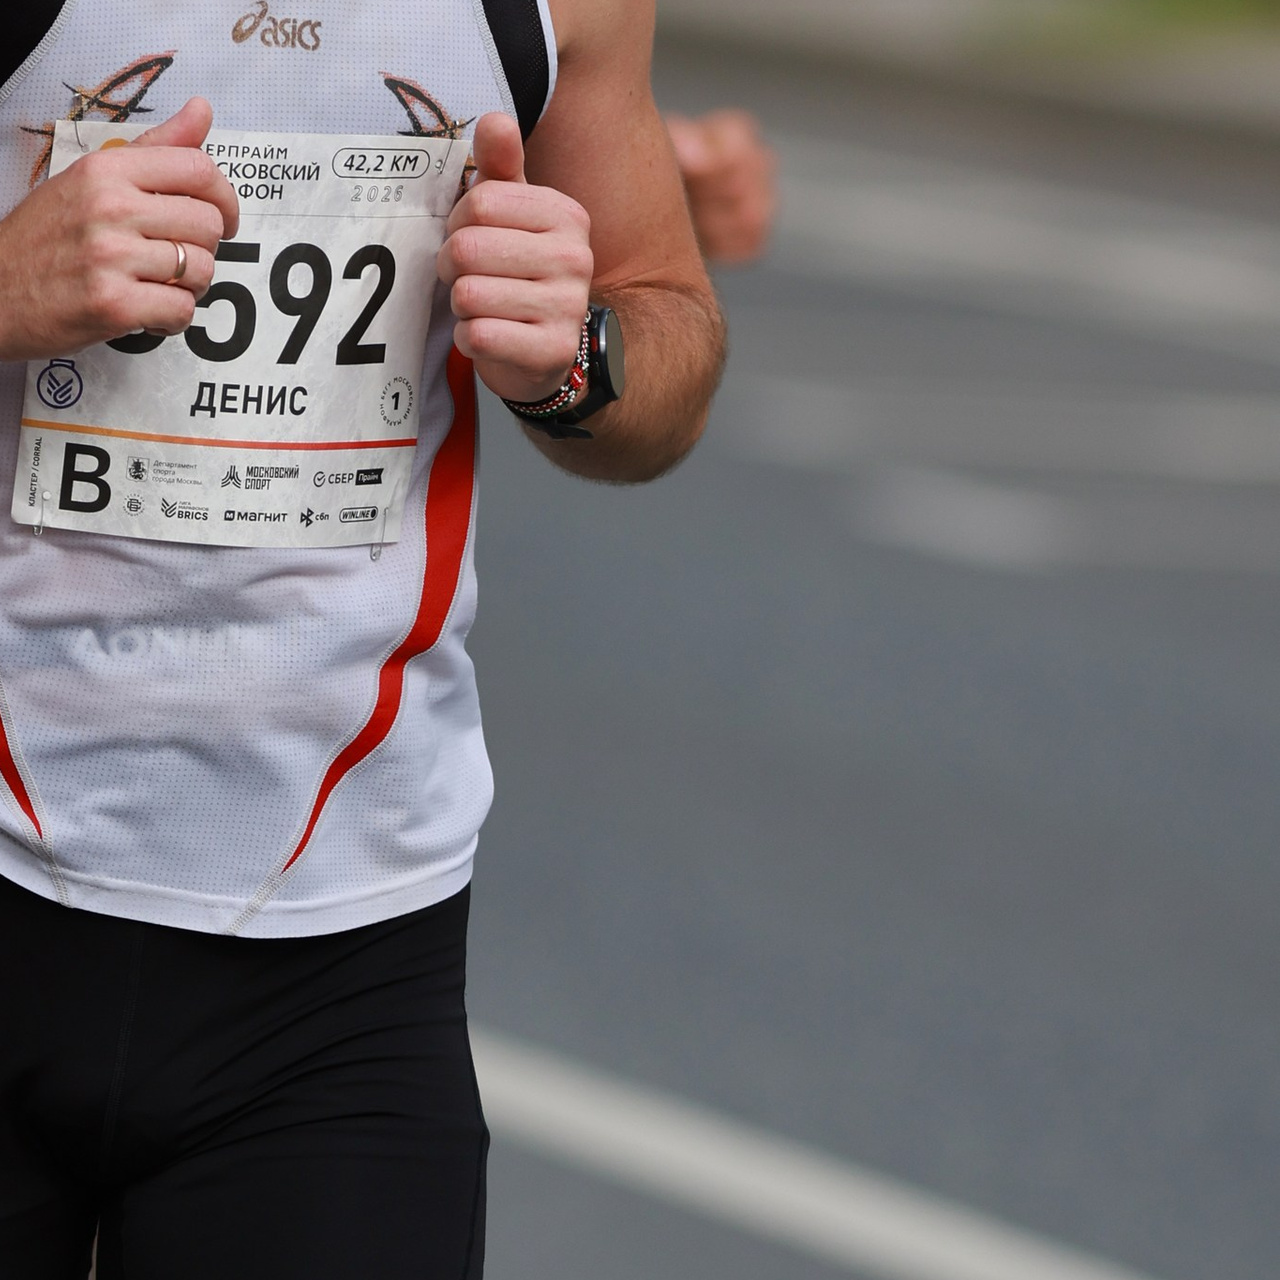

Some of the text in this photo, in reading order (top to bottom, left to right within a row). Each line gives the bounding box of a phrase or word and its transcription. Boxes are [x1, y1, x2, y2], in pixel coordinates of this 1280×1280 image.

[260, 16, 322, 51] asics
[204, 143, 288, 160] ЕРПРАЙМ
[343, 154, 384, 174] 42,2
[230, 183, 284, 200] ФОН
[350, 184, 404, 203] 2026
[105, 242, 397, 366] 592
[189, 381, 308, 418] ДЕНИС
[391, 391, 400, 411] 1
[32, 436, 42, 467] CORRAL
[153, 459, 198, 470] Департамент
[245, 464, 300, 479] МОСКОВСКИЙ
[151, 476, 175, 484] города
[244, 478, 272, 490] СПОРТ
[327, 472, 355, 485] СБЕР
[28, 473, 38, 507] КЛАСТЕР
[177, 510, 209, 521] BRICS
[237, 511, 288, 522] магнит
[314, 512, 330, 521] сбп
[341, 509, 371, 520] WINLINE
